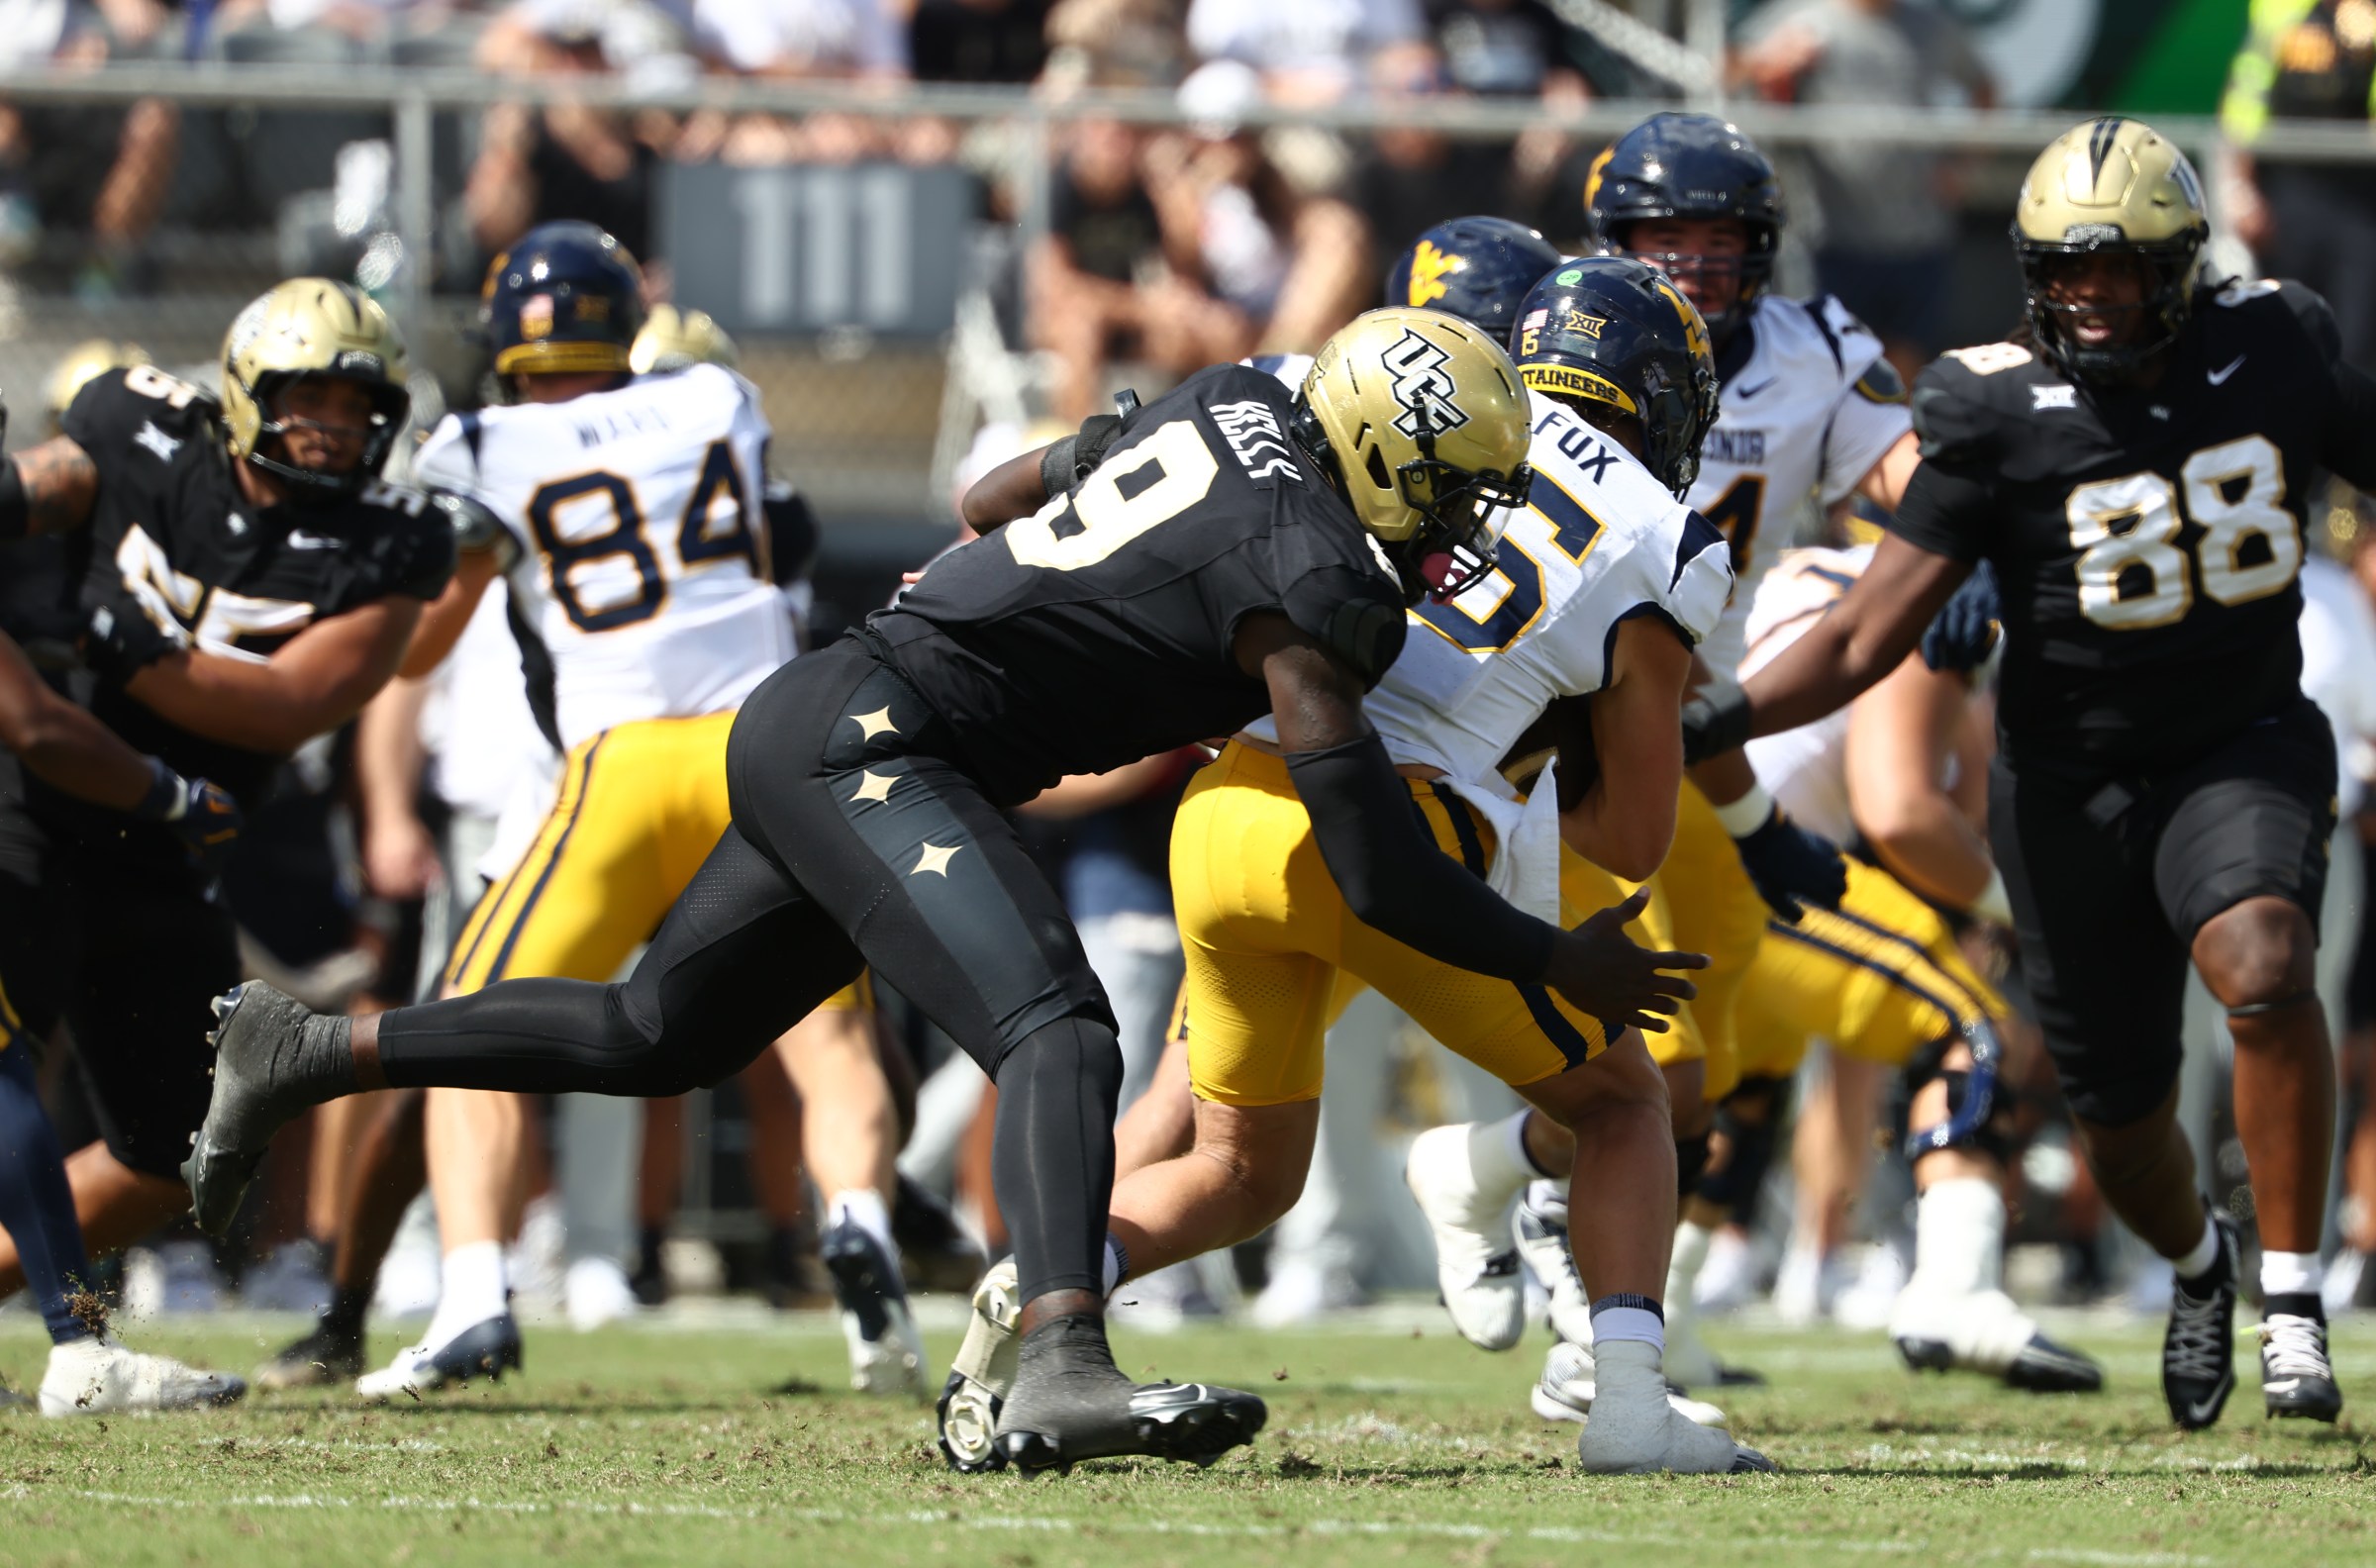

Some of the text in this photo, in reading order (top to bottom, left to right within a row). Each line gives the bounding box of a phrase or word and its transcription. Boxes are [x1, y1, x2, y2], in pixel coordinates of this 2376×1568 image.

[1381, 327, 1473, 439] UCF
[1521, 368, 1621, 403] TAINEERS
[1004, 420, 1219, 572] 9
[1208, 400, 1303, 482] KELLY
[1534, 411, 1623, 486] FOX
[525, 438, 762, 635] 84
[2065, 434, 2303, 631] 88
